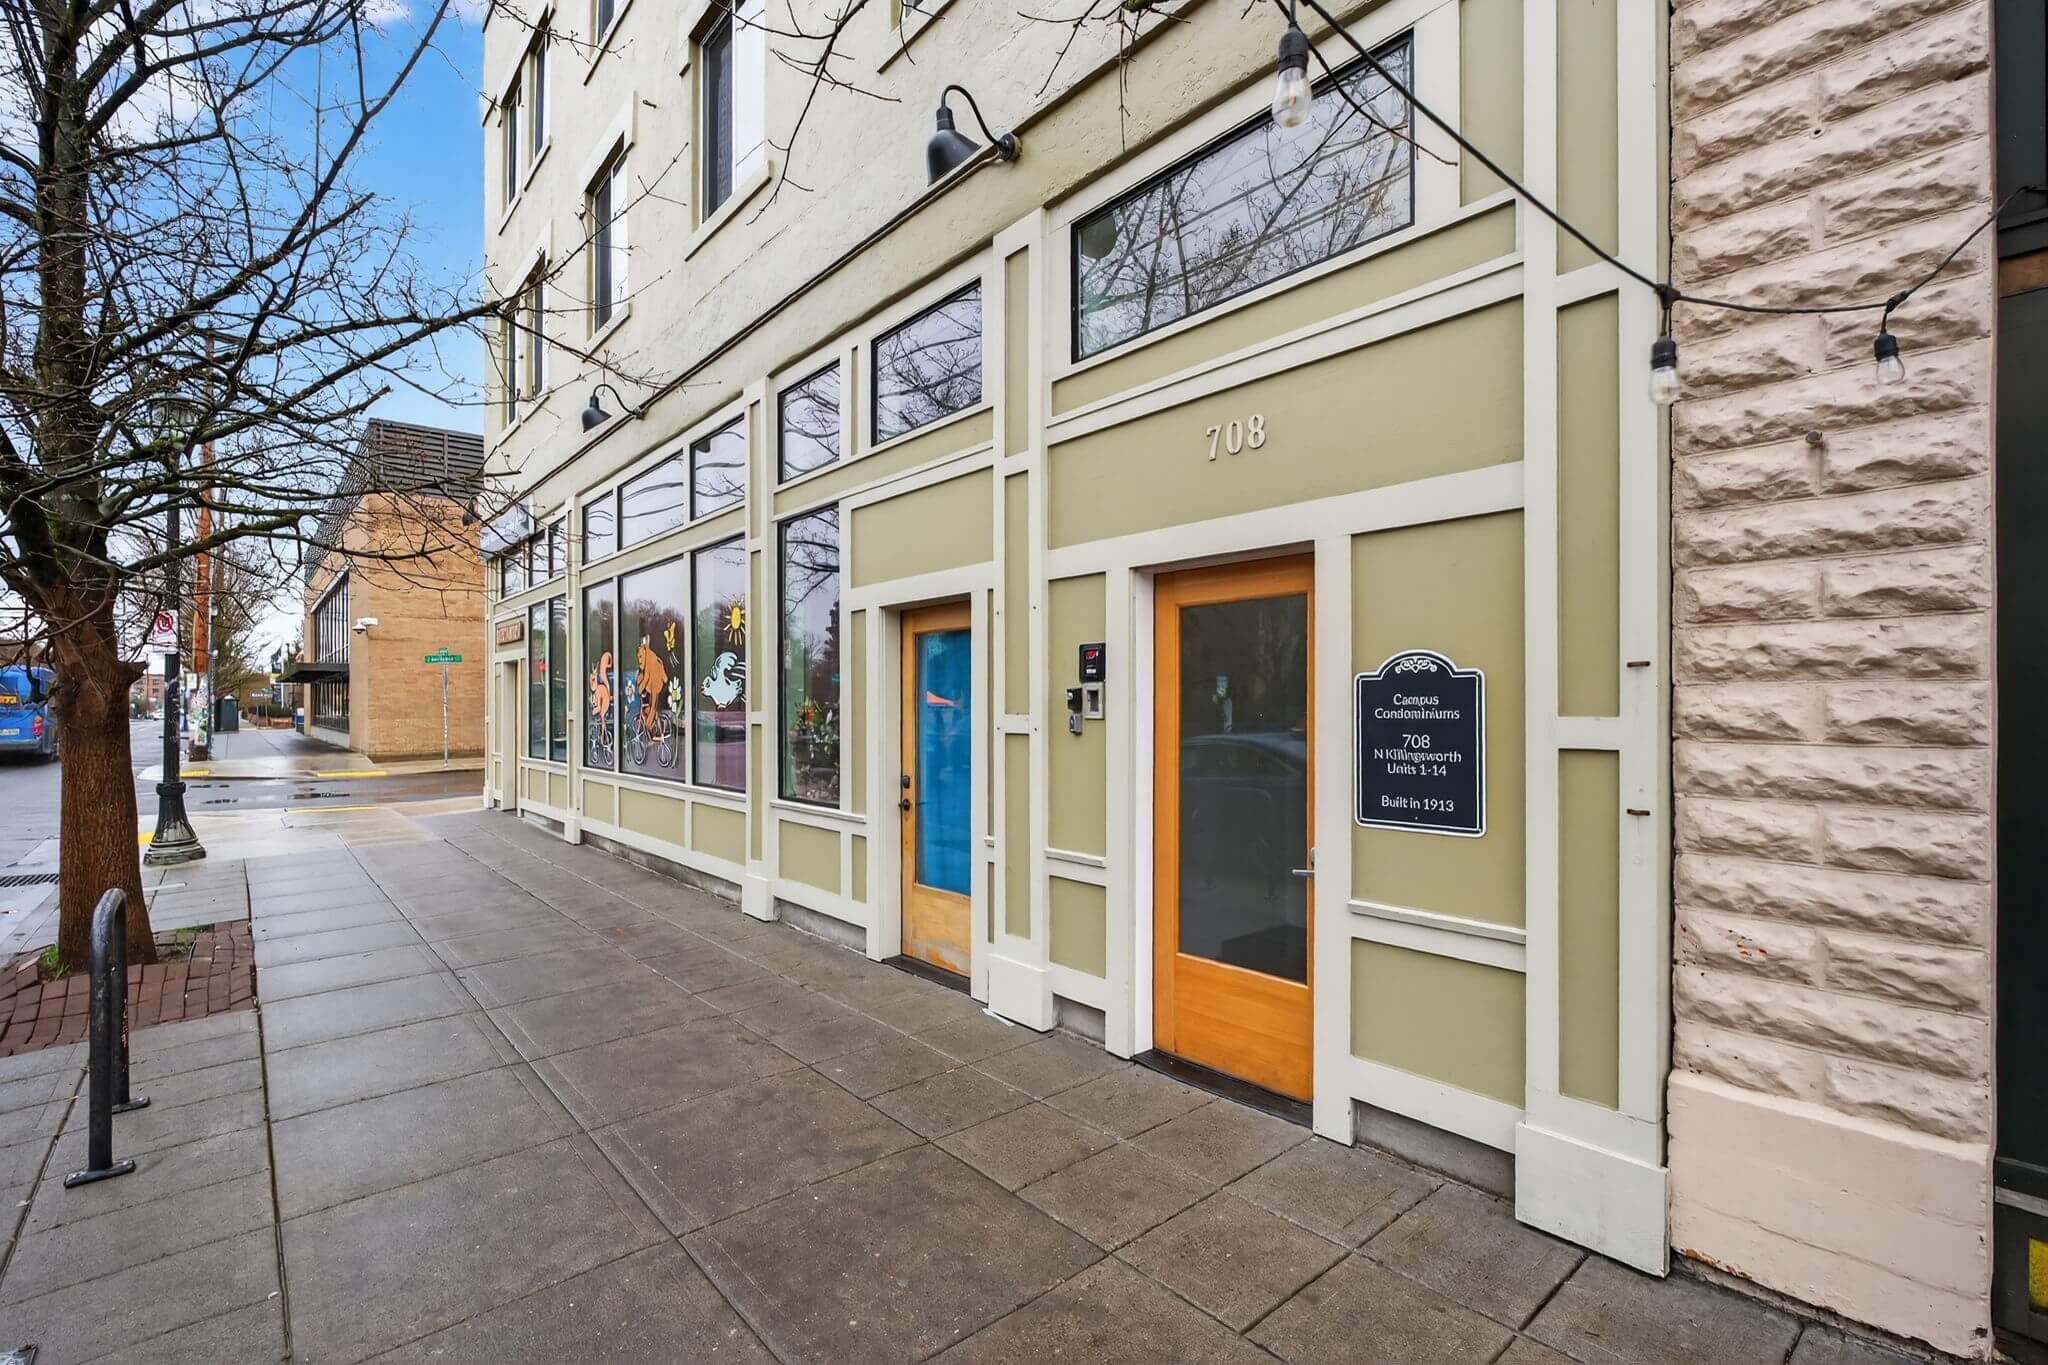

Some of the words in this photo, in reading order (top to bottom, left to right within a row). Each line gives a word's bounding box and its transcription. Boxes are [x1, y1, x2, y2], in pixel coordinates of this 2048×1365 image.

[1206, 414, 1266, 461] 708
[1393, 693, 1439, 707] Campus
[1374, 707, 1460, 720] Condominiums
[1402, 734, 1431, 749] 708
[1374, 748, 1383, 760] N
[1387, 763, 1417, 775] Units
[1420, 764, 1447, 776] 1-14
[1381, 795, 1408, 809] Built
[1410, 796, 1420, 809] in
[1422, 798, 1454, 812] 1913
